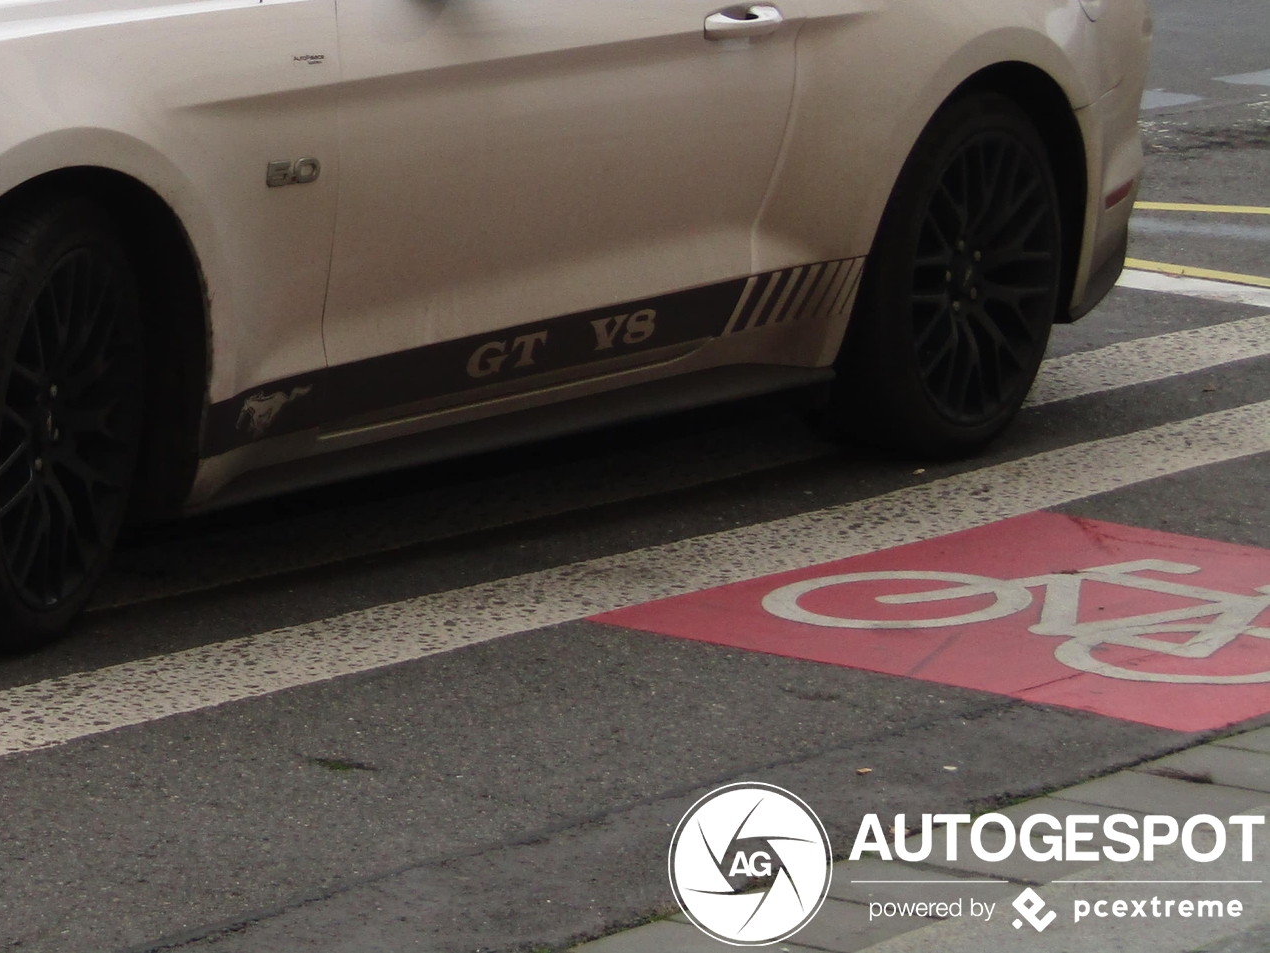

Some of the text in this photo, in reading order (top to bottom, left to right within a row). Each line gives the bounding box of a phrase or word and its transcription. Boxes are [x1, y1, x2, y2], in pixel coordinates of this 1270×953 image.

[266, 157, 321, 188] 5.0
[466, 308, 657, 378] GT V8
